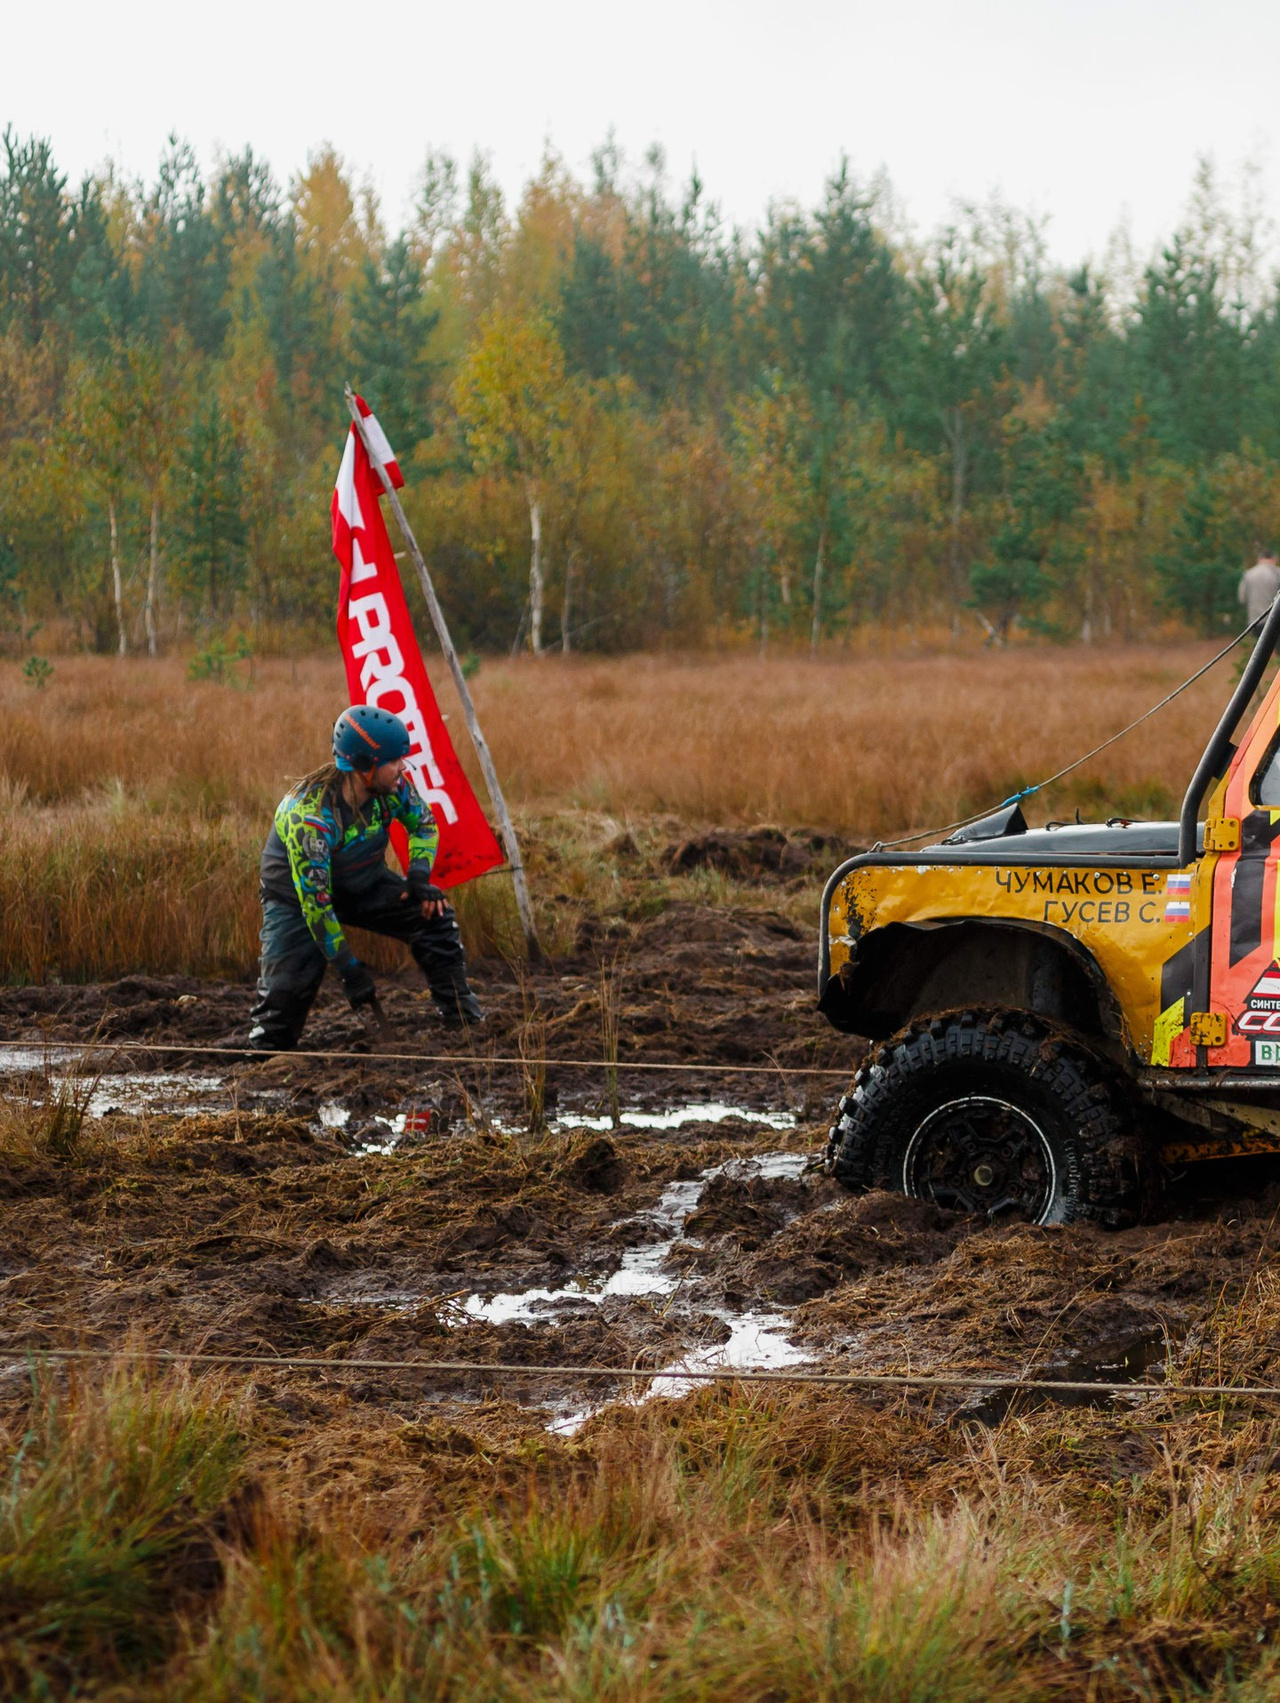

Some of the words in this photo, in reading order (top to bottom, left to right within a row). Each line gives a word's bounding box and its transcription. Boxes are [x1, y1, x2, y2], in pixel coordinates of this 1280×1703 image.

[348, 538, 459, 825] UPROTEC
[995, 870, 1133, 895] ЧУМАКОВ
[1043, 900, 1130, 923] ГУСЕВ
